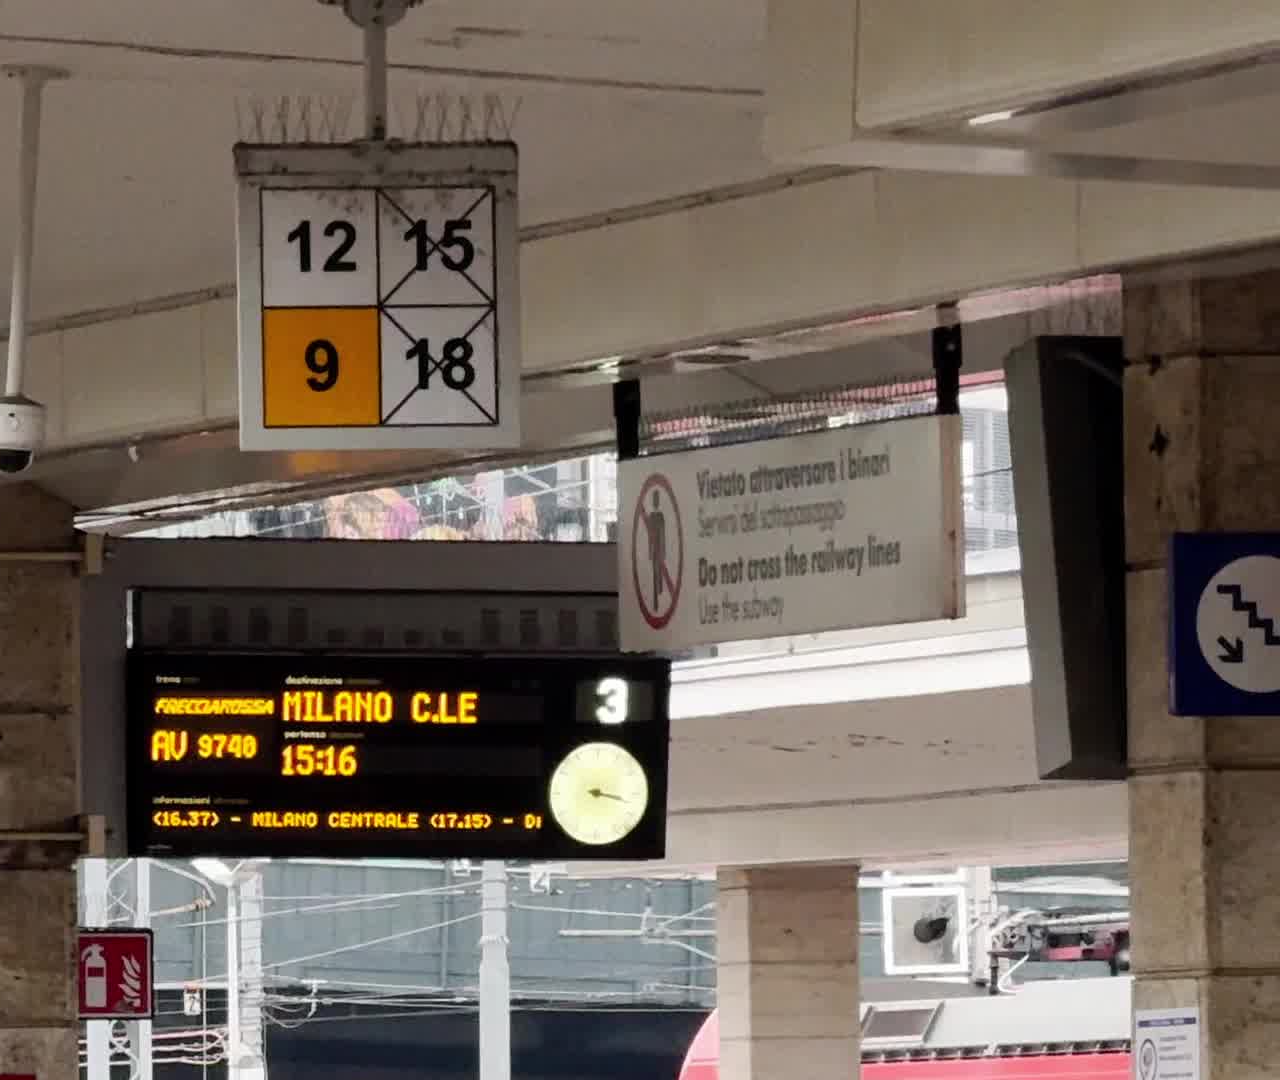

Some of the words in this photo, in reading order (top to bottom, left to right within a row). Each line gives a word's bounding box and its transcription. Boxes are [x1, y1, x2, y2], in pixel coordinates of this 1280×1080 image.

[287, 220, 357, 273] 12
[403, 219, 475, 272] 15
[304, 338, 340, 392] 9
[405, 337, 476, 391] 18
[696, 468, 745, 499] Vietato
[750, 459, 836, 495] attraversare
[847, 446, 890, 480] binari
[698, 557, 717, 587] Do
[720, 552, 744, 584] not
[748, 553, 782, 583] cross
[784, 545, 807, 579] the
[810, 539, 864, 577] railway
[867, 535, 902, 567] lines
[698, 598, 719, 625] Use
[721, 595, 741, 622] the
[743, 588, 785, 625] subway
[154, 697, 275, 715] FRECCIAROSSA
[282, 690, 393, 723] MILANO
[411, 691, 479, 724] C.LE
[595, 677, 629, 724] 3
[150, 729, 188, 762] AV
[197, 733, 258, 759] 9740
[280, 744, 358, 777] 15:16
[152, 810, 220, 828] (16.37)
[251, 811, 319, 829] MILANO
[328, 811, 420, 830] CENTRALE
[430, 812, 492, 830] (17.15)
